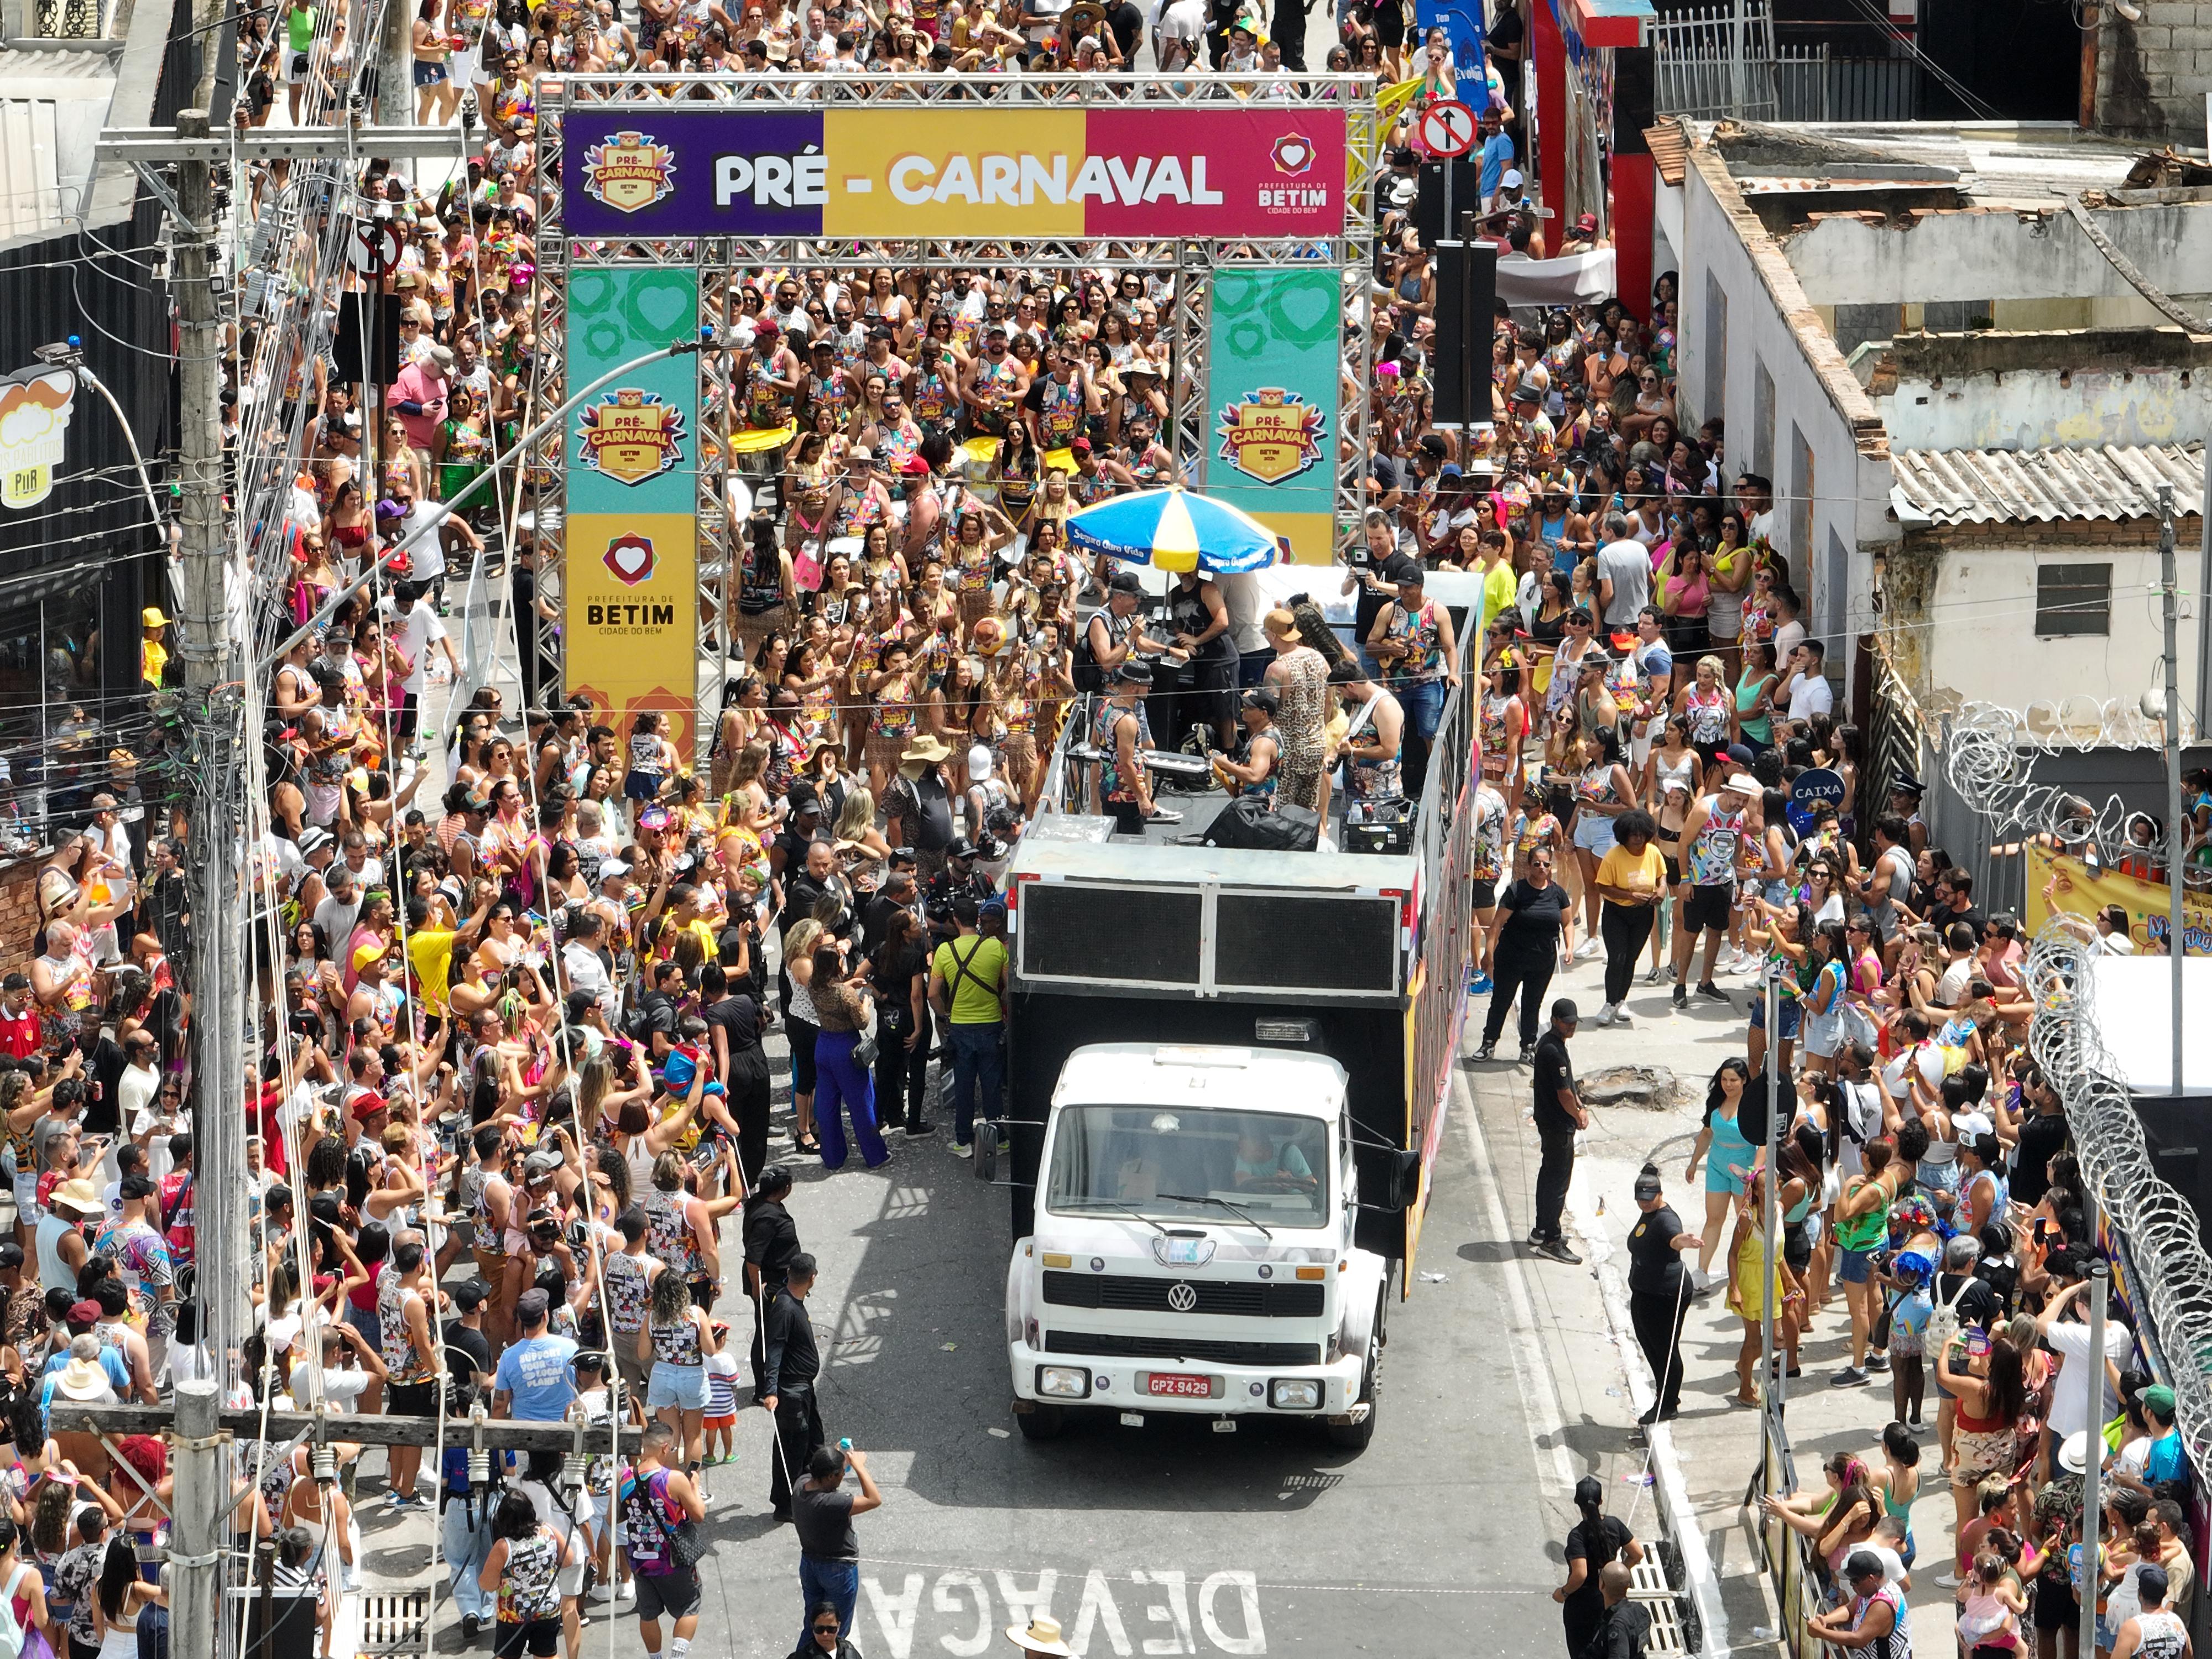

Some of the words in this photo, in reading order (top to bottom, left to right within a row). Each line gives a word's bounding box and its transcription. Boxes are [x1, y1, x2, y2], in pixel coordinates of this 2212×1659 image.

[617, 155, 641, 165] PRÉ-
[596, 167, 662, 181] CARNAVAL
[716, 144, 828, 207] PRÉ
[889, 155, 1223, 206] CARNAVAL
[1259, 190, 1327, 206] BETIM
[615, 415, 645, 427] PRÉ-
[1256, 415, 1285, 426] PRÉ-
[591, 430, 669, 446] CARNAVAL
[1232, 429, 1309, 445] CARNAVAL
[1073, 529, 1100, 546] Seguro
[1102, 540, 1121, 552] Ouro
[1124, 545, 1144, 557] Vida
[588, 605, 673, 625] BETIM
[1796, 785, 1841, 799] CAIXA
[519, 1348, 561, 1363] SUPPORT
[520, 1360, 546, 1373] YOUR
[536, 1367, 562, 1378] LOCAL
[526, 1375, 560, 1388] PLANET
[848, 1569, 1267, 1659] DEVAGA
